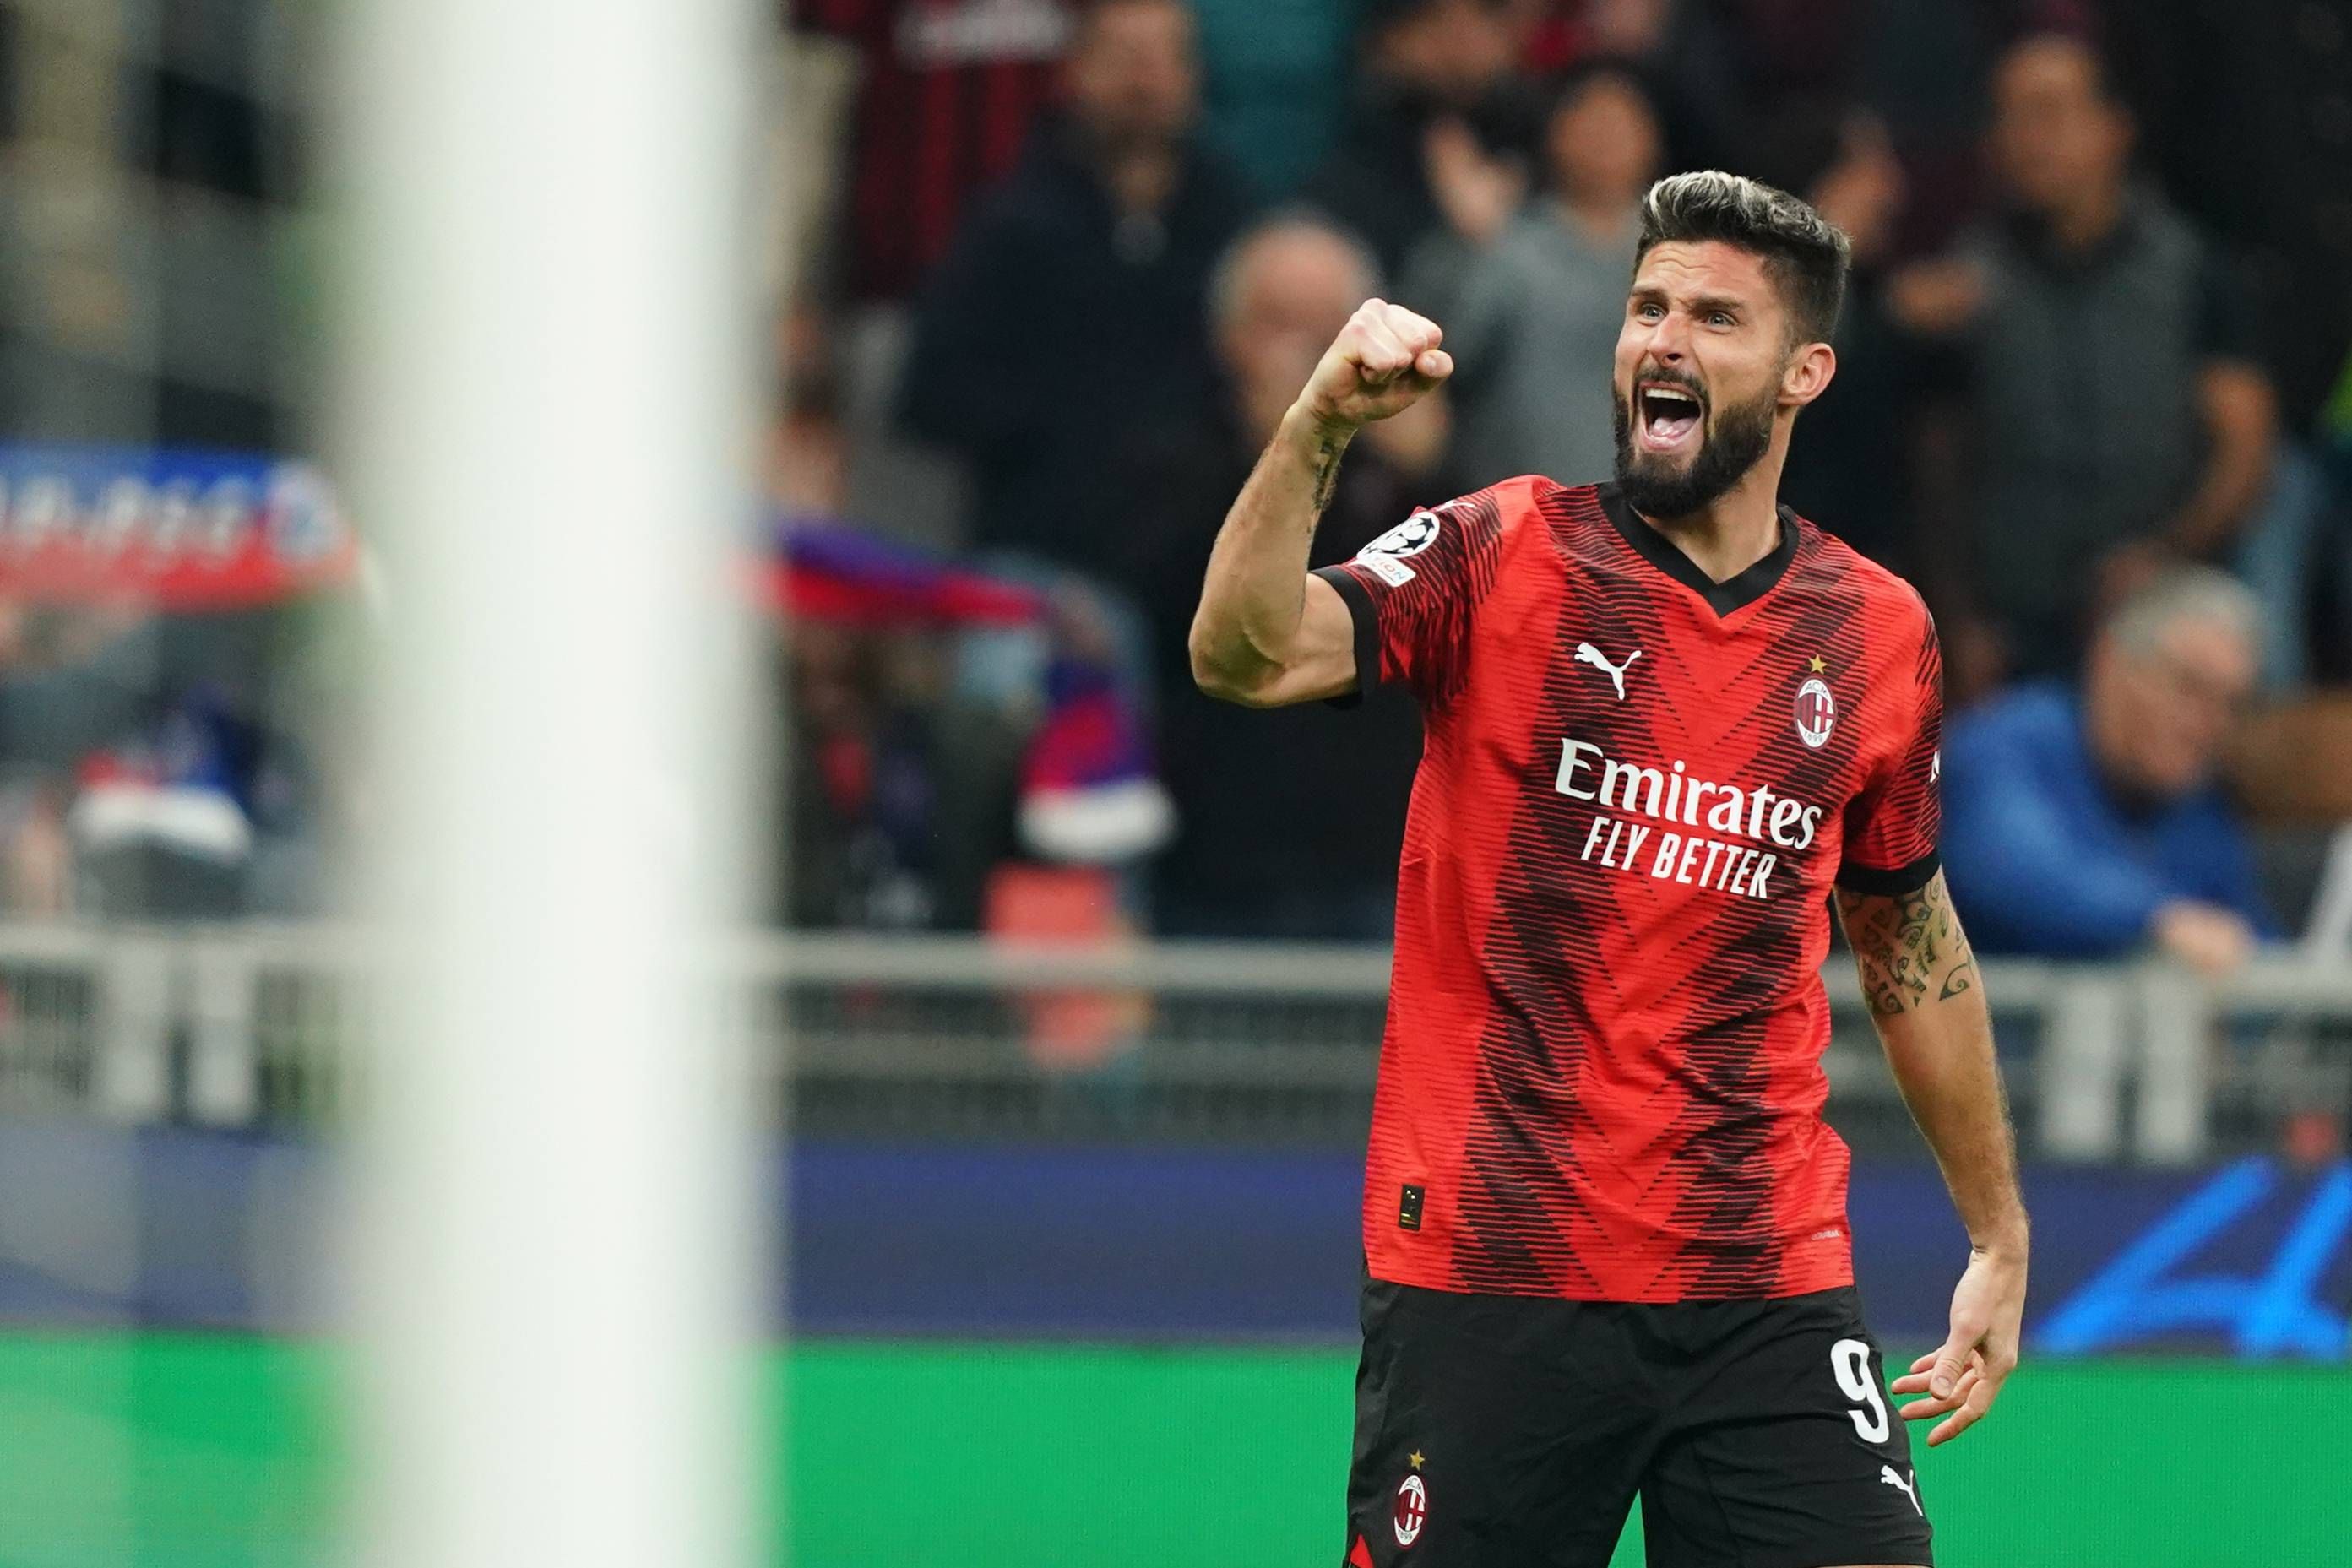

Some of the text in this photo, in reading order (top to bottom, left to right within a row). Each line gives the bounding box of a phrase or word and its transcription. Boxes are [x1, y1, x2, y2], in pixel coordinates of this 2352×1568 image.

[1803, 730, 1825, 742] 1899
[1555, 737, 1822, 850] Emirates
[1580, 816, 1777, 899] FLY BETTER
[1831, 1339, 1890, 1444] 9
